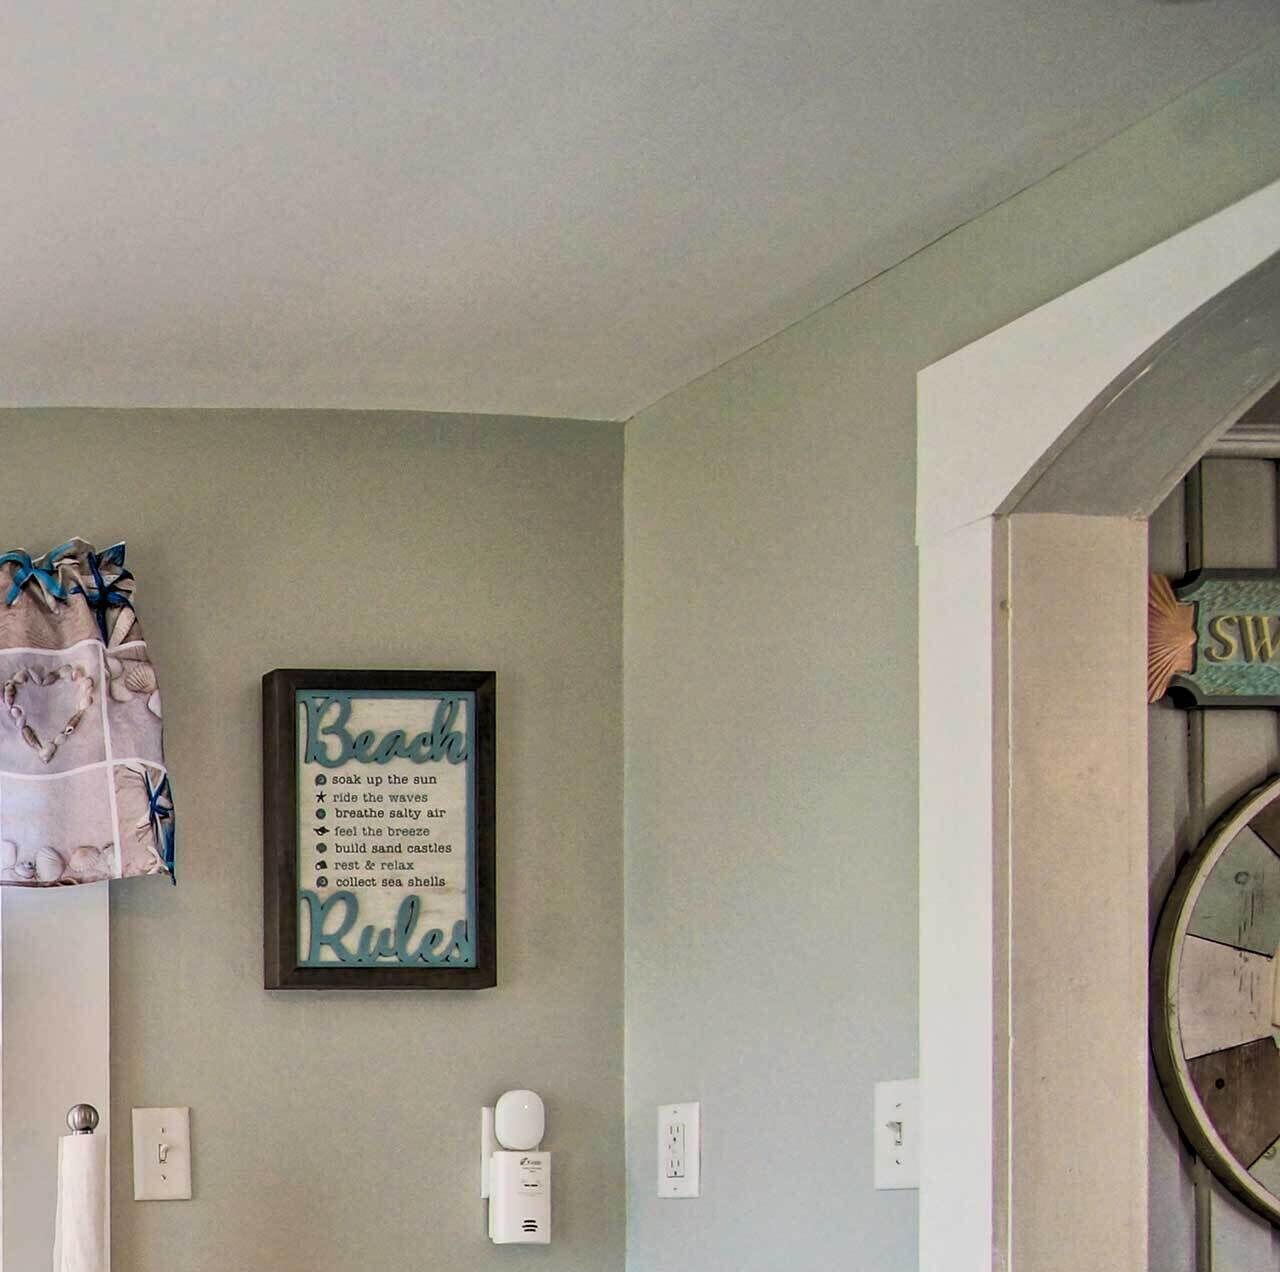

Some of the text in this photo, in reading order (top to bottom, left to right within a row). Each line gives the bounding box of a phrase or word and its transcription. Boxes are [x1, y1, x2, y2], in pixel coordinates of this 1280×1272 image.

[298, 696, 468, 768] Beach
[332, 774, 437, 787] soak up the sun
[333, 792, 428, 803] ride the waves
[335, 808, 447, 820] breathe salty air
[334, 826, 430, 836] feel the breeze
[334, 843, 452, 854] build sand castles
[334, 860, 414, 870] rest & relax
[336, 876, 446, 887] collect sea shells
[299, 890, 468, 963] Rules
